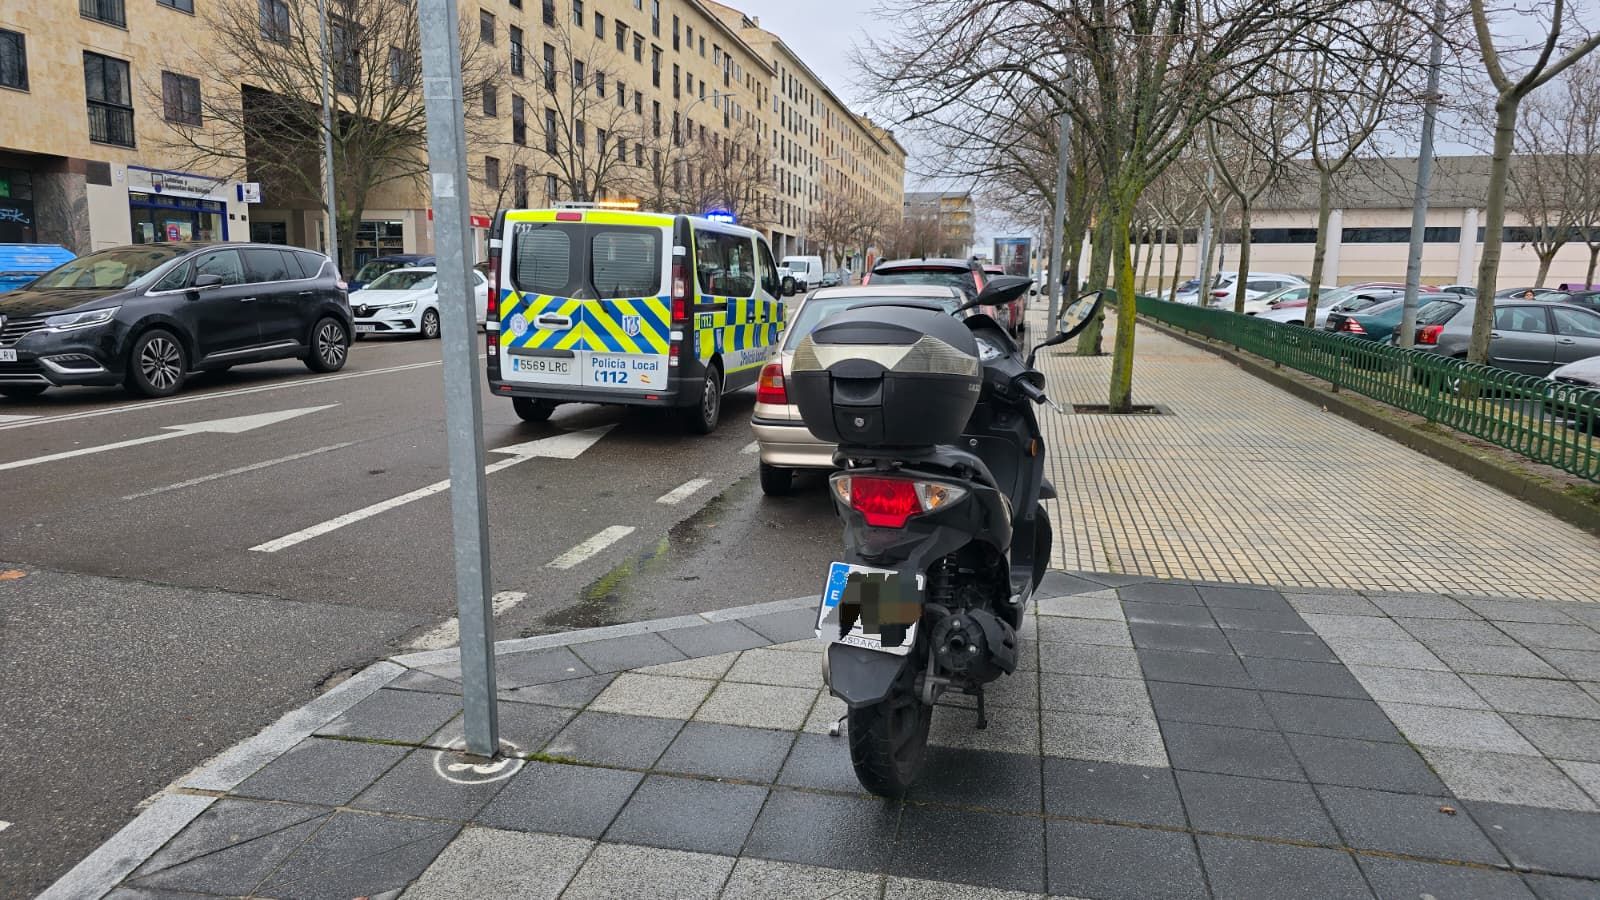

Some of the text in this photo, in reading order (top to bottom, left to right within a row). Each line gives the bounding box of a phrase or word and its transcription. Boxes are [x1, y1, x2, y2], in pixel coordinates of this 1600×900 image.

[515, 223, 532, 233] 717
[701, 315, 713, 328] 112
[520, 359, 568, 373] 5569 LRC
[592, 357, 659, 371] Policía Local
[600, 371, 628, 384] 112
[831, 591, 840, 600] E
